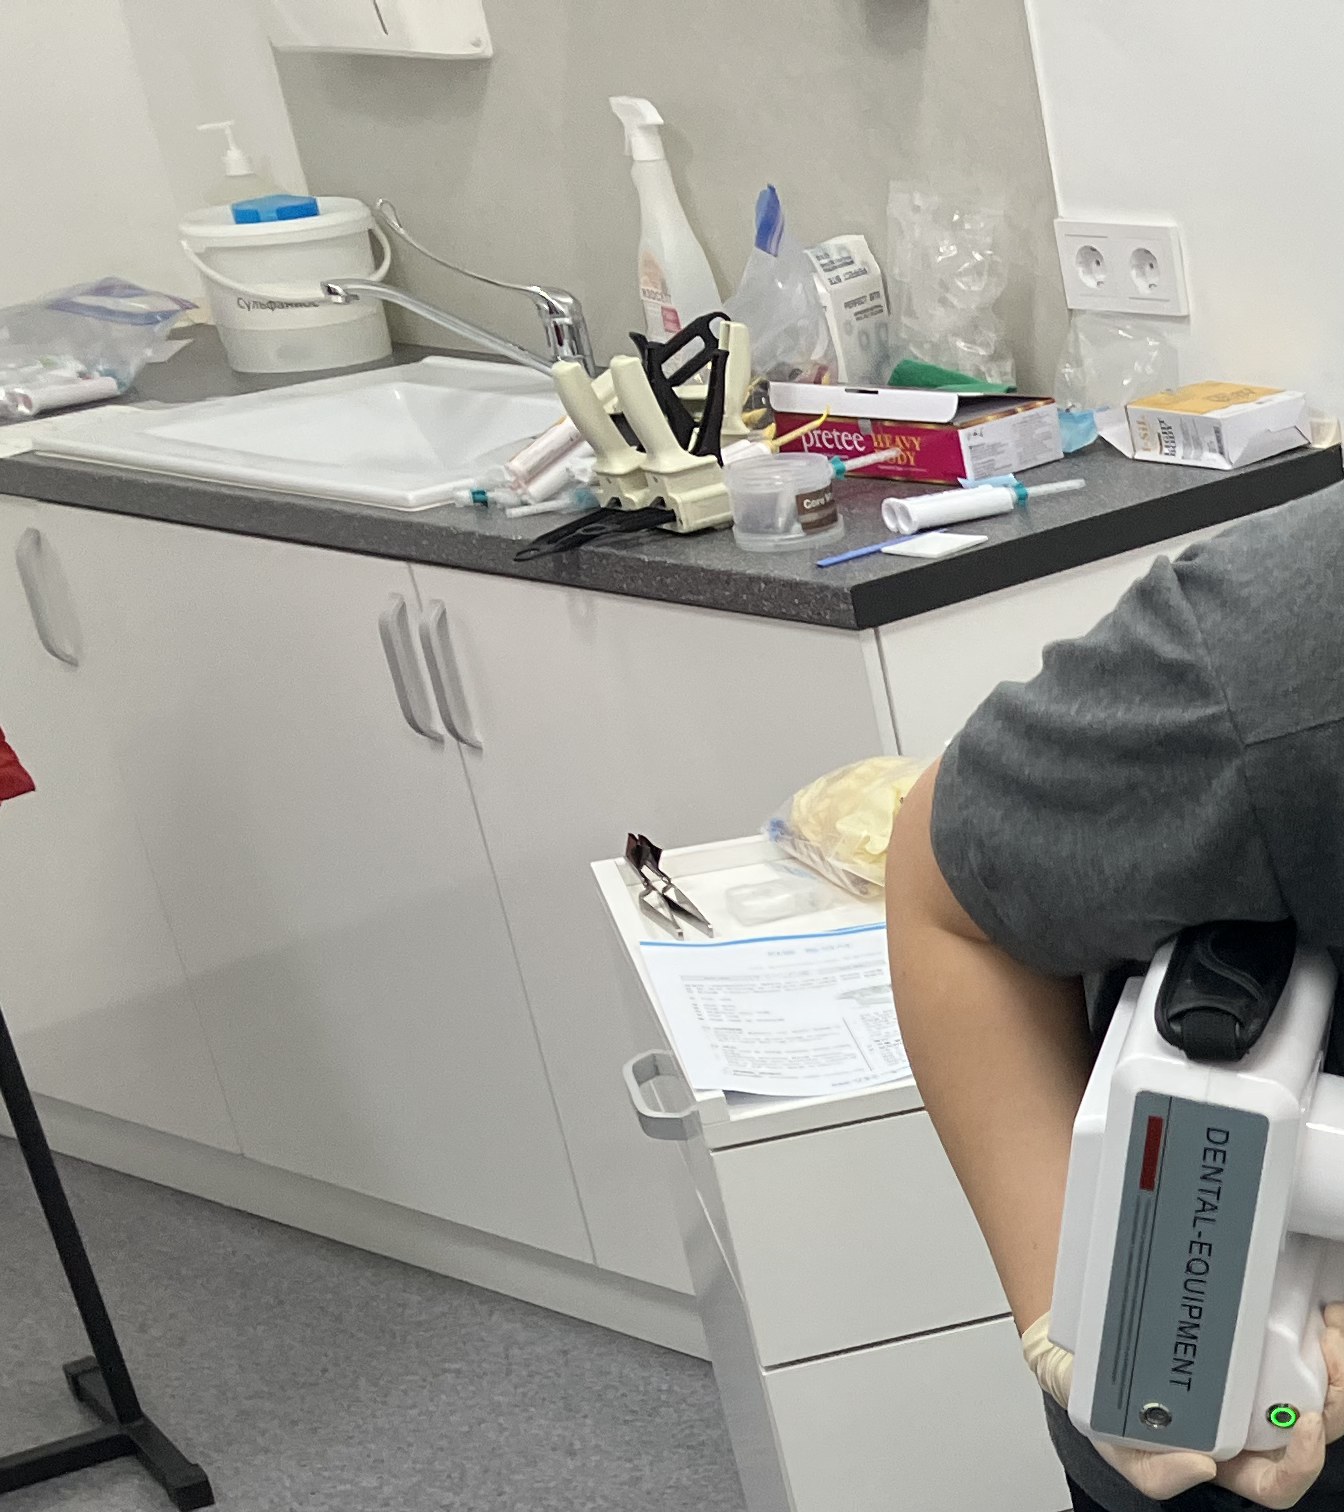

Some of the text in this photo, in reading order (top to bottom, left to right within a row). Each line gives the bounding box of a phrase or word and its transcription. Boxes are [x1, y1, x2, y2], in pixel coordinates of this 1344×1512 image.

[802, 429, 866, 453] pretee
[871, 433, 920, 451] HEAVY
[1169, 1127, 1230, 1392] DENTAL-EQUIPMENT
